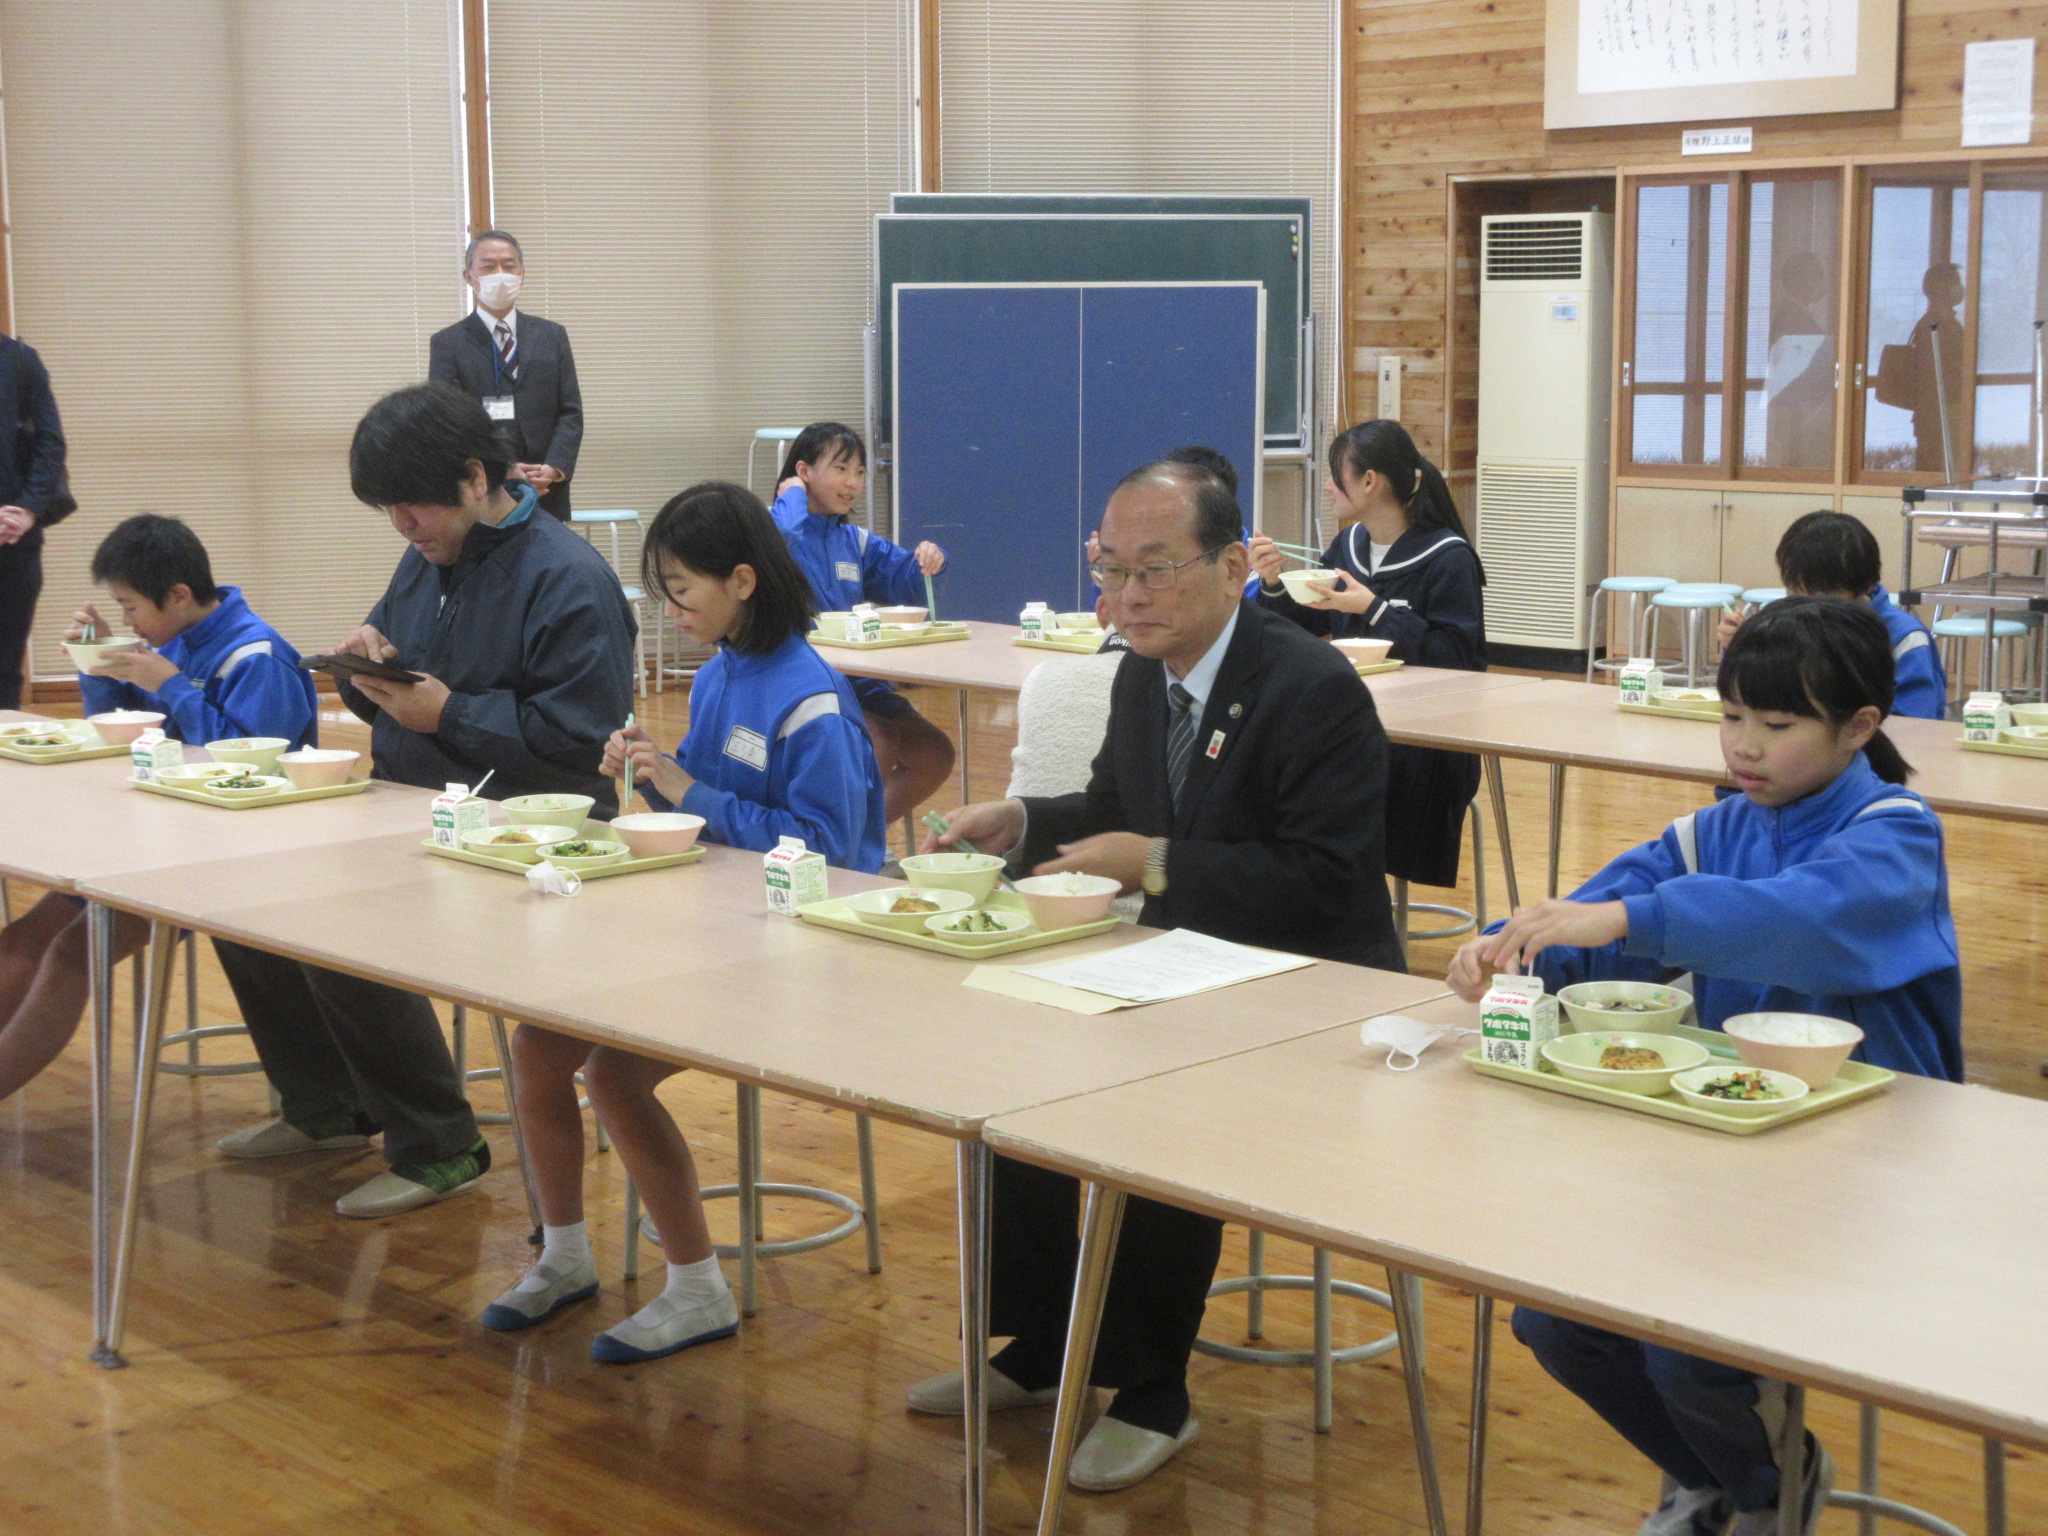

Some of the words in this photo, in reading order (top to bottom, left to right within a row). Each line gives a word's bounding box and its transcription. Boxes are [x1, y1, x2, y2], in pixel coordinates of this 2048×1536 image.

[1489, 996, 1528, 1005] クボタ牛乳
[1483, 1018, 1529, 1032] クボタ牛乳
